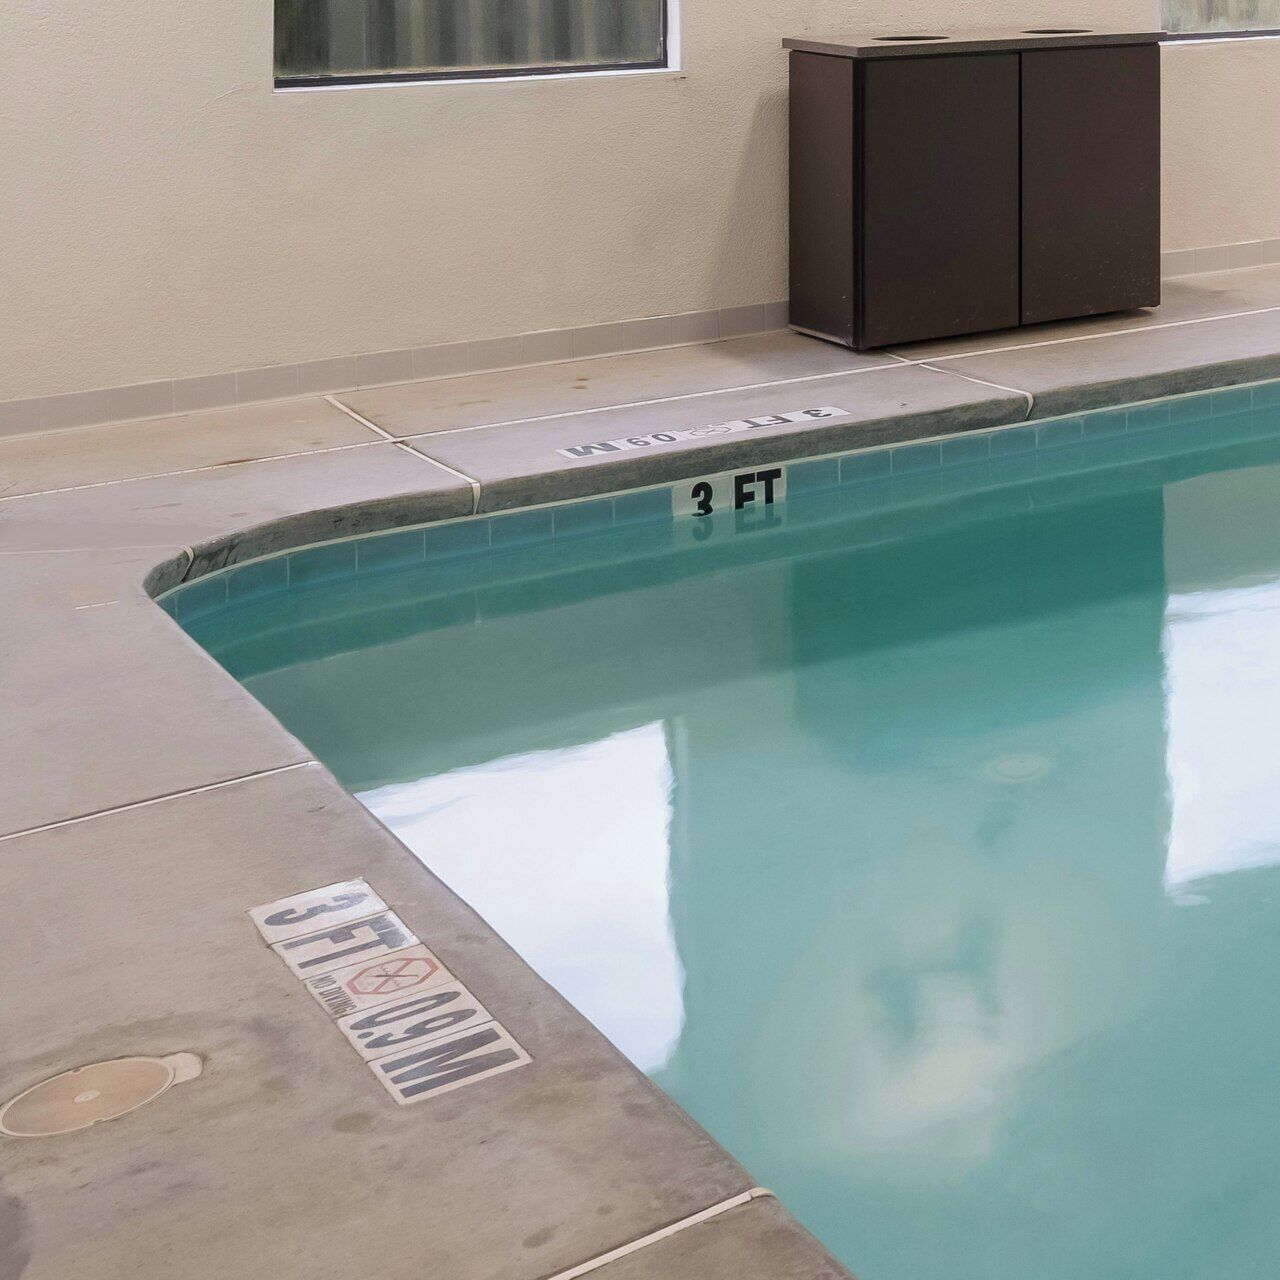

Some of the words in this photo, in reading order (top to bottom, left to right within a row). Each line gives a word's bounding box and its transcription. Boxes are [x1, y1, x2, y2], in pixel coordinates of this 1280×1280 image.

[746, 415, 794, 429] FT
[802, 409, 832, 418] 3
[565, 442, 621, 457] M
[690, 482, 714, 517] 3
[734, 468, 782, 511] FT
[263, 892, 368, 926] 3
[282, 913, 412, 969] FT
[308, 974, 337, 989] NO
[318, 986, 358, 1015] DIVING
[349, 990, 478, 1049] 0.9
[379, 1026, 521, 1099] M
